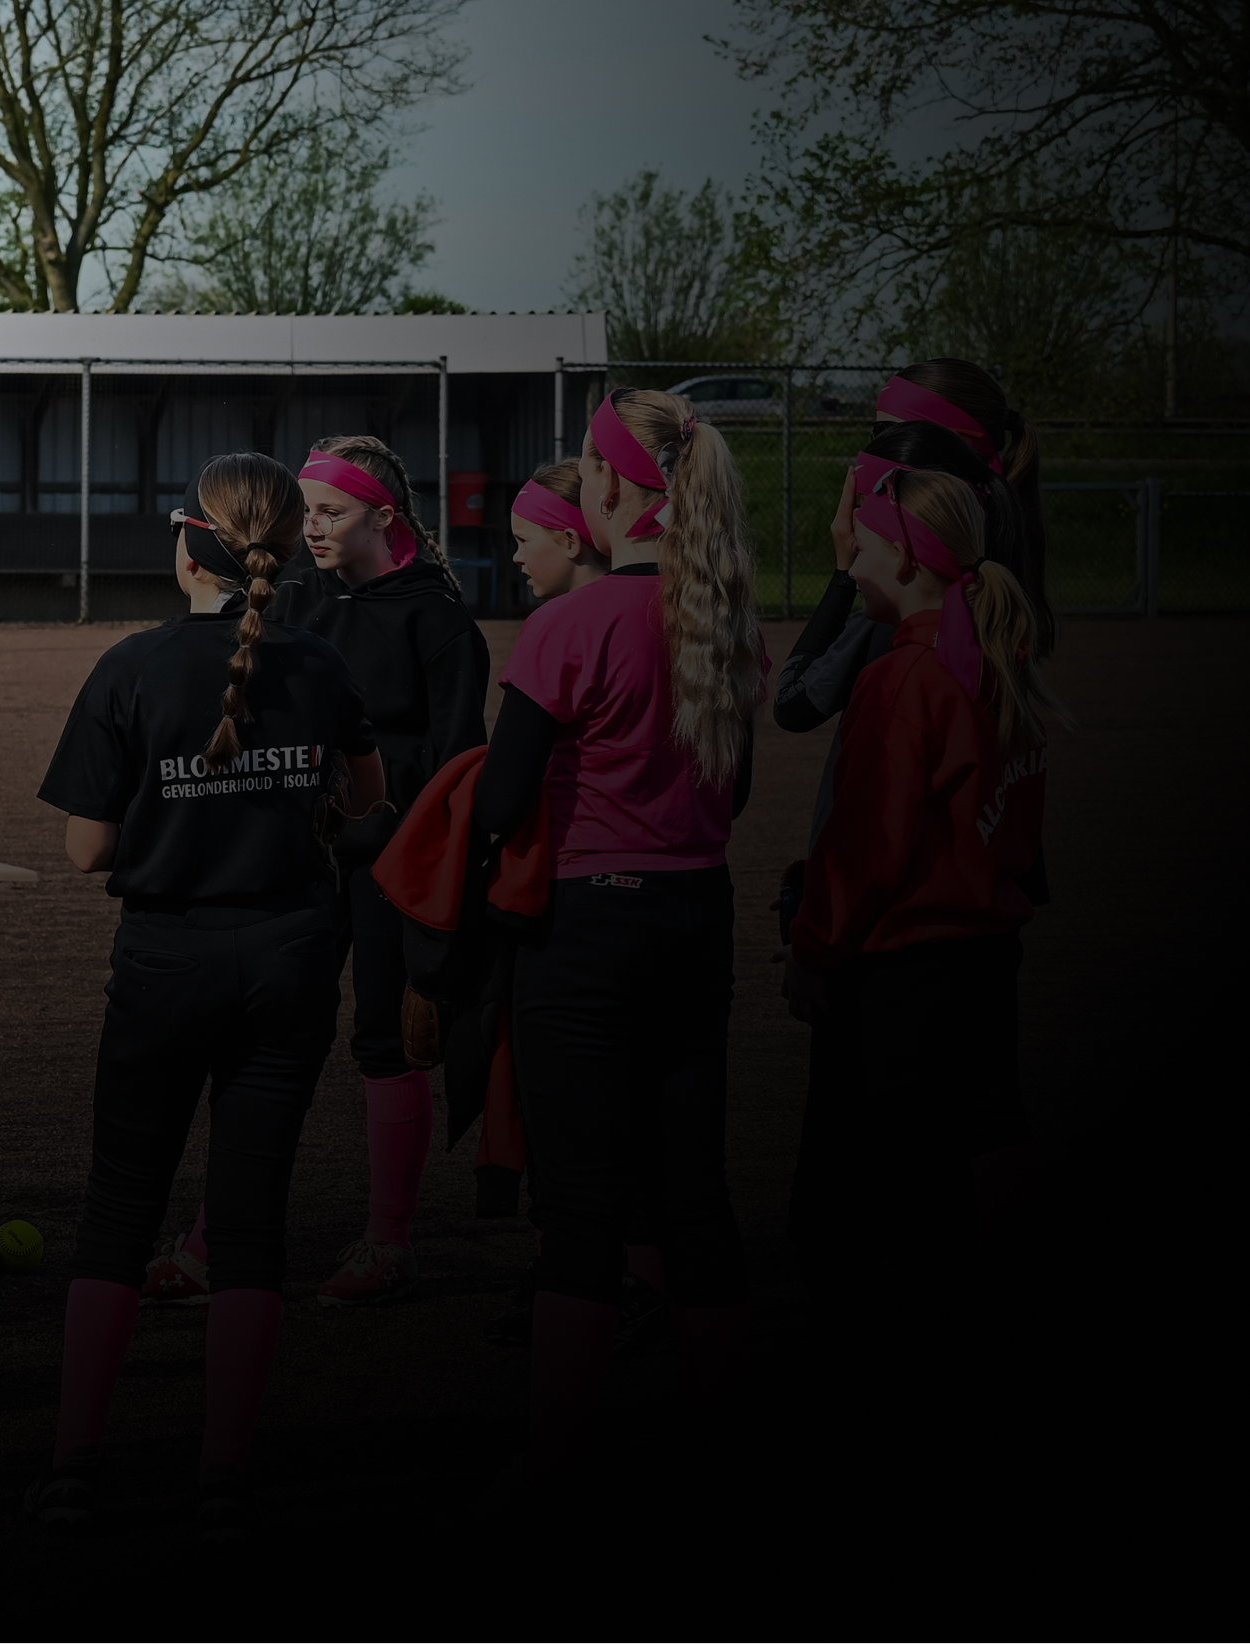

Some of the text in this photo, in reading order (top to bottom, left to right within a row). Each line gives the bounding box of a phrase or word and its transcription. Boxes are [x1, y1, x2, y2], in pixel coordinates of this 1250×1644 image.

[160, 745, 325, 781] BLOMESTEIN
[161, 776, 272, 799] GEVELONDERHOUD
[975, 747, 1048, 847] ALCARIA
[613, 877, 641, 887] SSK
